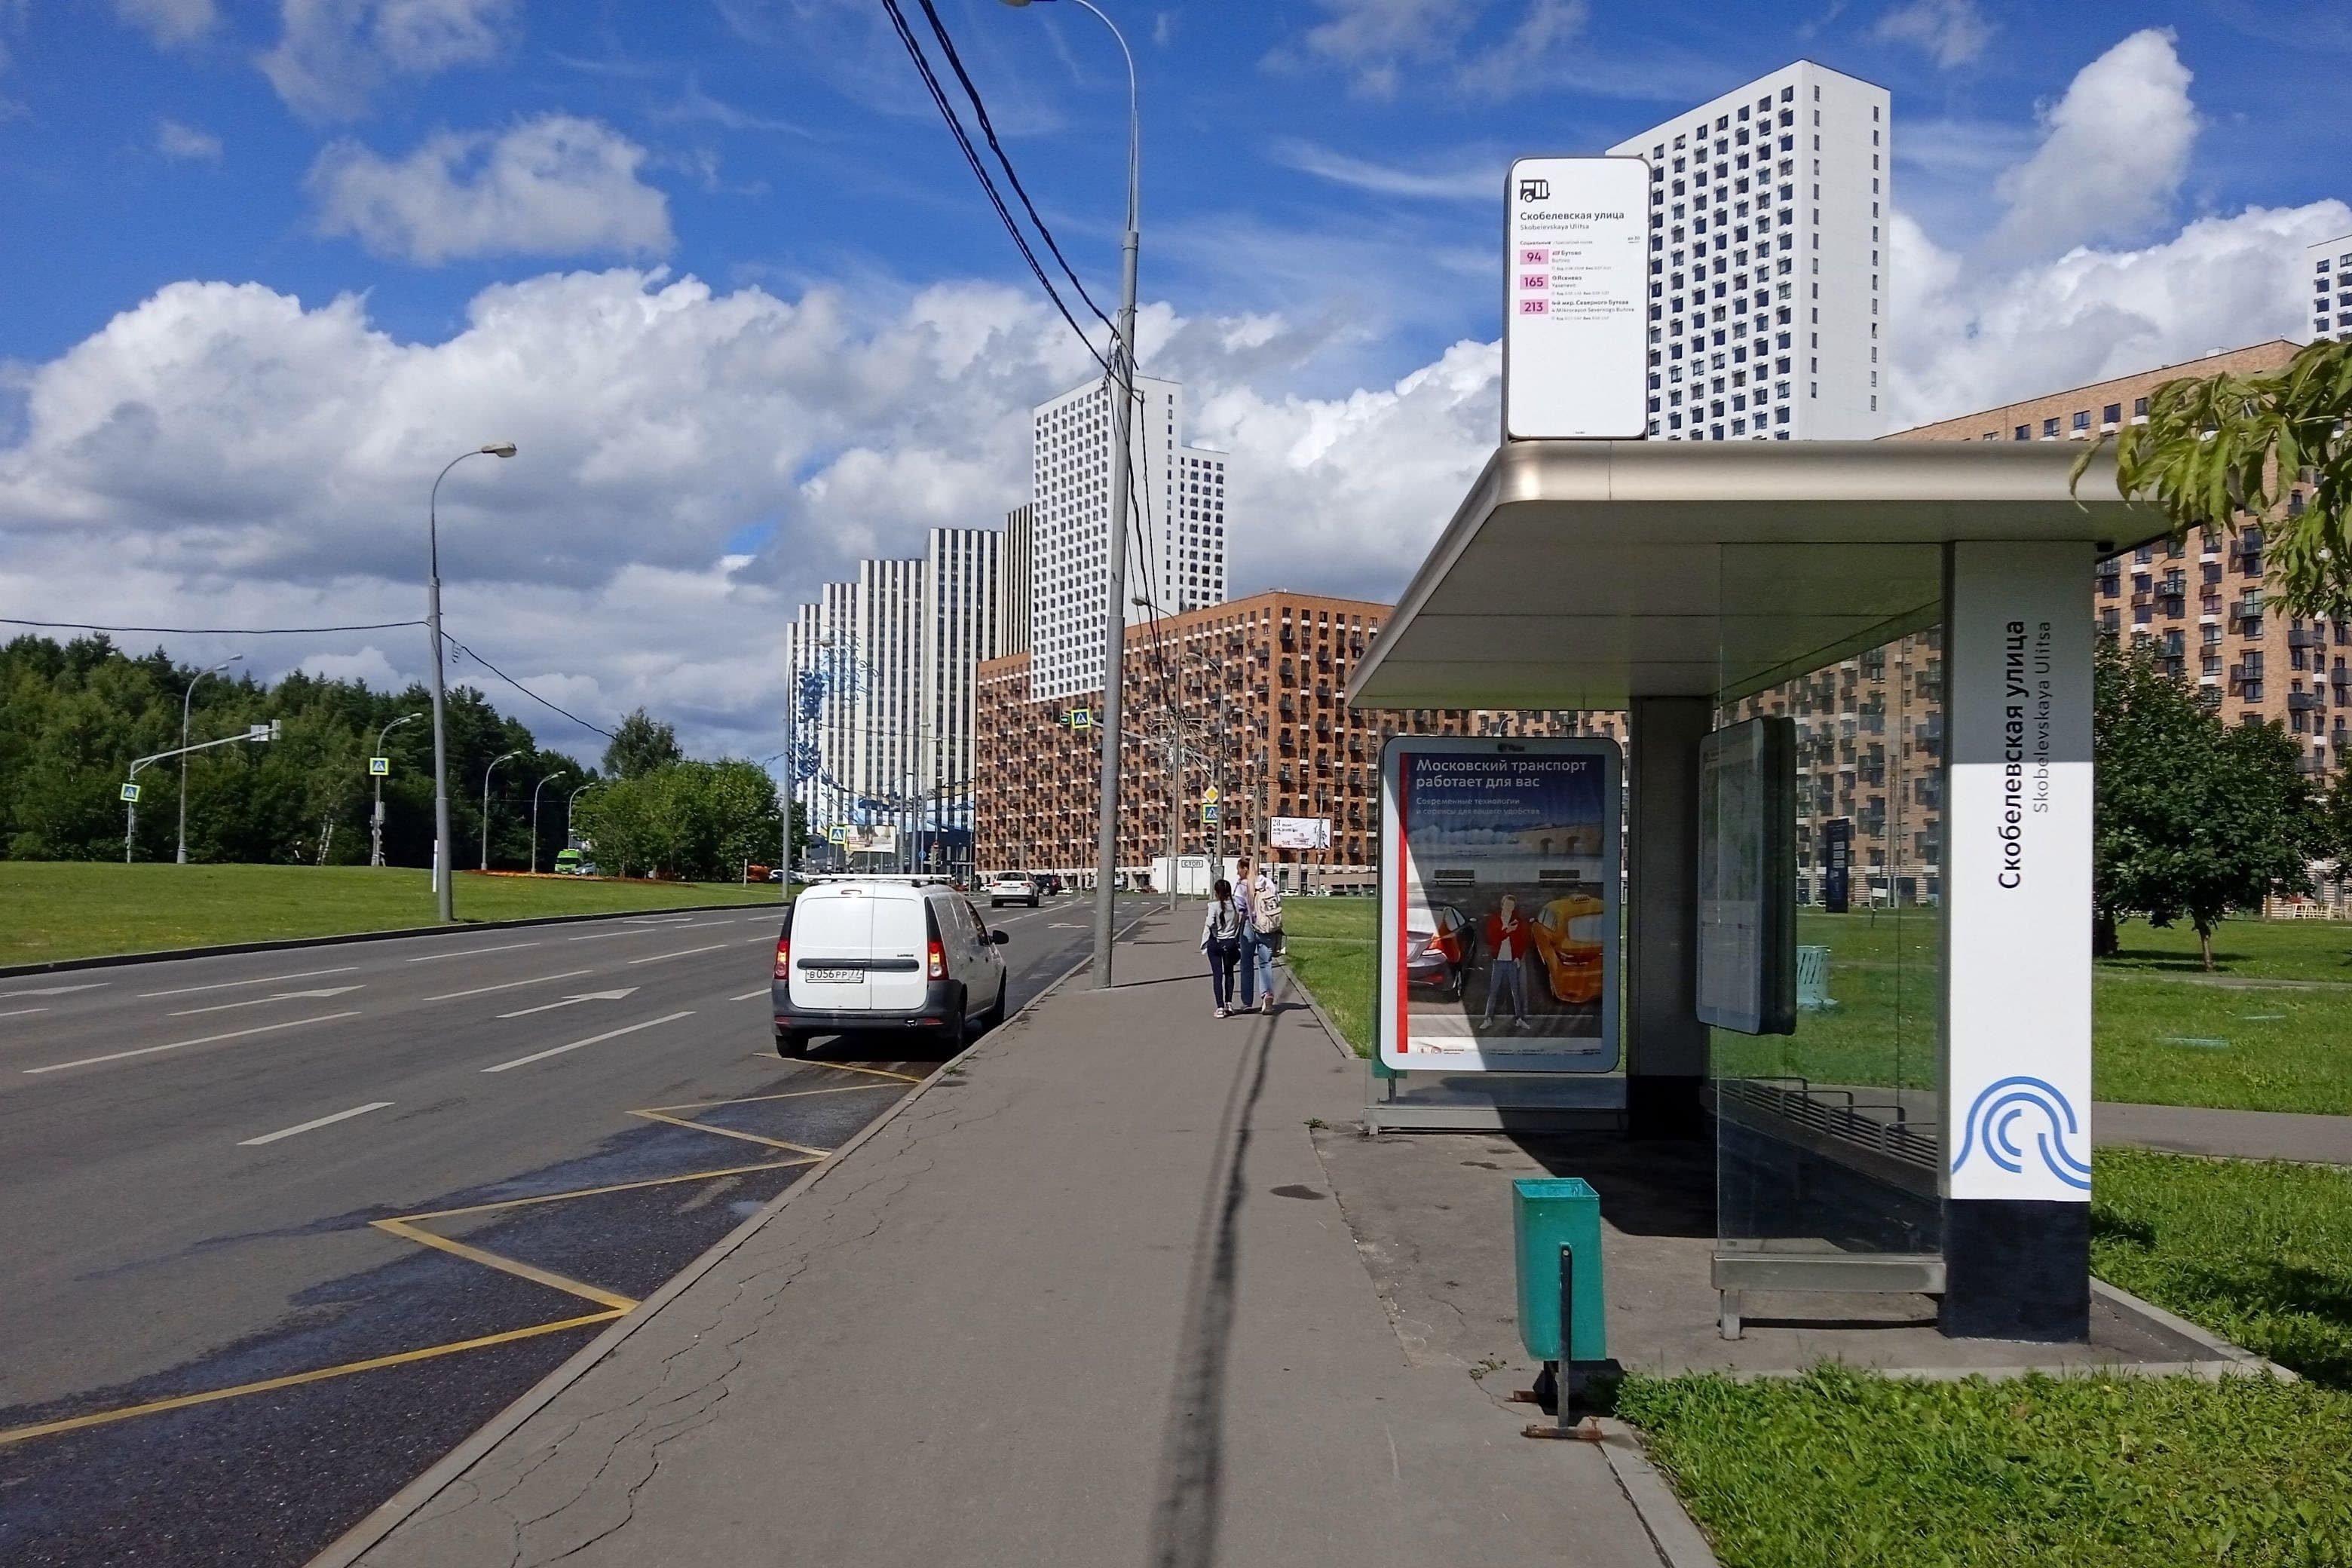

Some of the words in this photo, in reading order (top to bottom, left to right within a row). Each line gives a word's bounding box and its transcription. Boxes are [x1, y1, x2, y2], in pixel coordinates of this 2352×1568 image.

[1520, 211, 1591, 221] Скобелевская
[1594, 212, 1625, 222] улица
[1527, 252, 1542, 262] 94
[1524, 277, 1543, 287] 165
[1524, 302, 1543, 312] 213
[2034, 621, 2051, 674] Ulitsa
[2006, 620, 2029, 698] улица
[2033, 680, 2053, 813] Skobelevskaya
[1416, 759, 1508, 771] Московский
[1511, 761, 1587, 773] транспорт
[1416, 775, 1482, 789] работает
[1485, 777, 1511, 789] для
[1515, 777, 1540, 787] вас
[1416, 797, 1472, 806] Современные
[1997, 706, 2023, 889] Скобелевская
